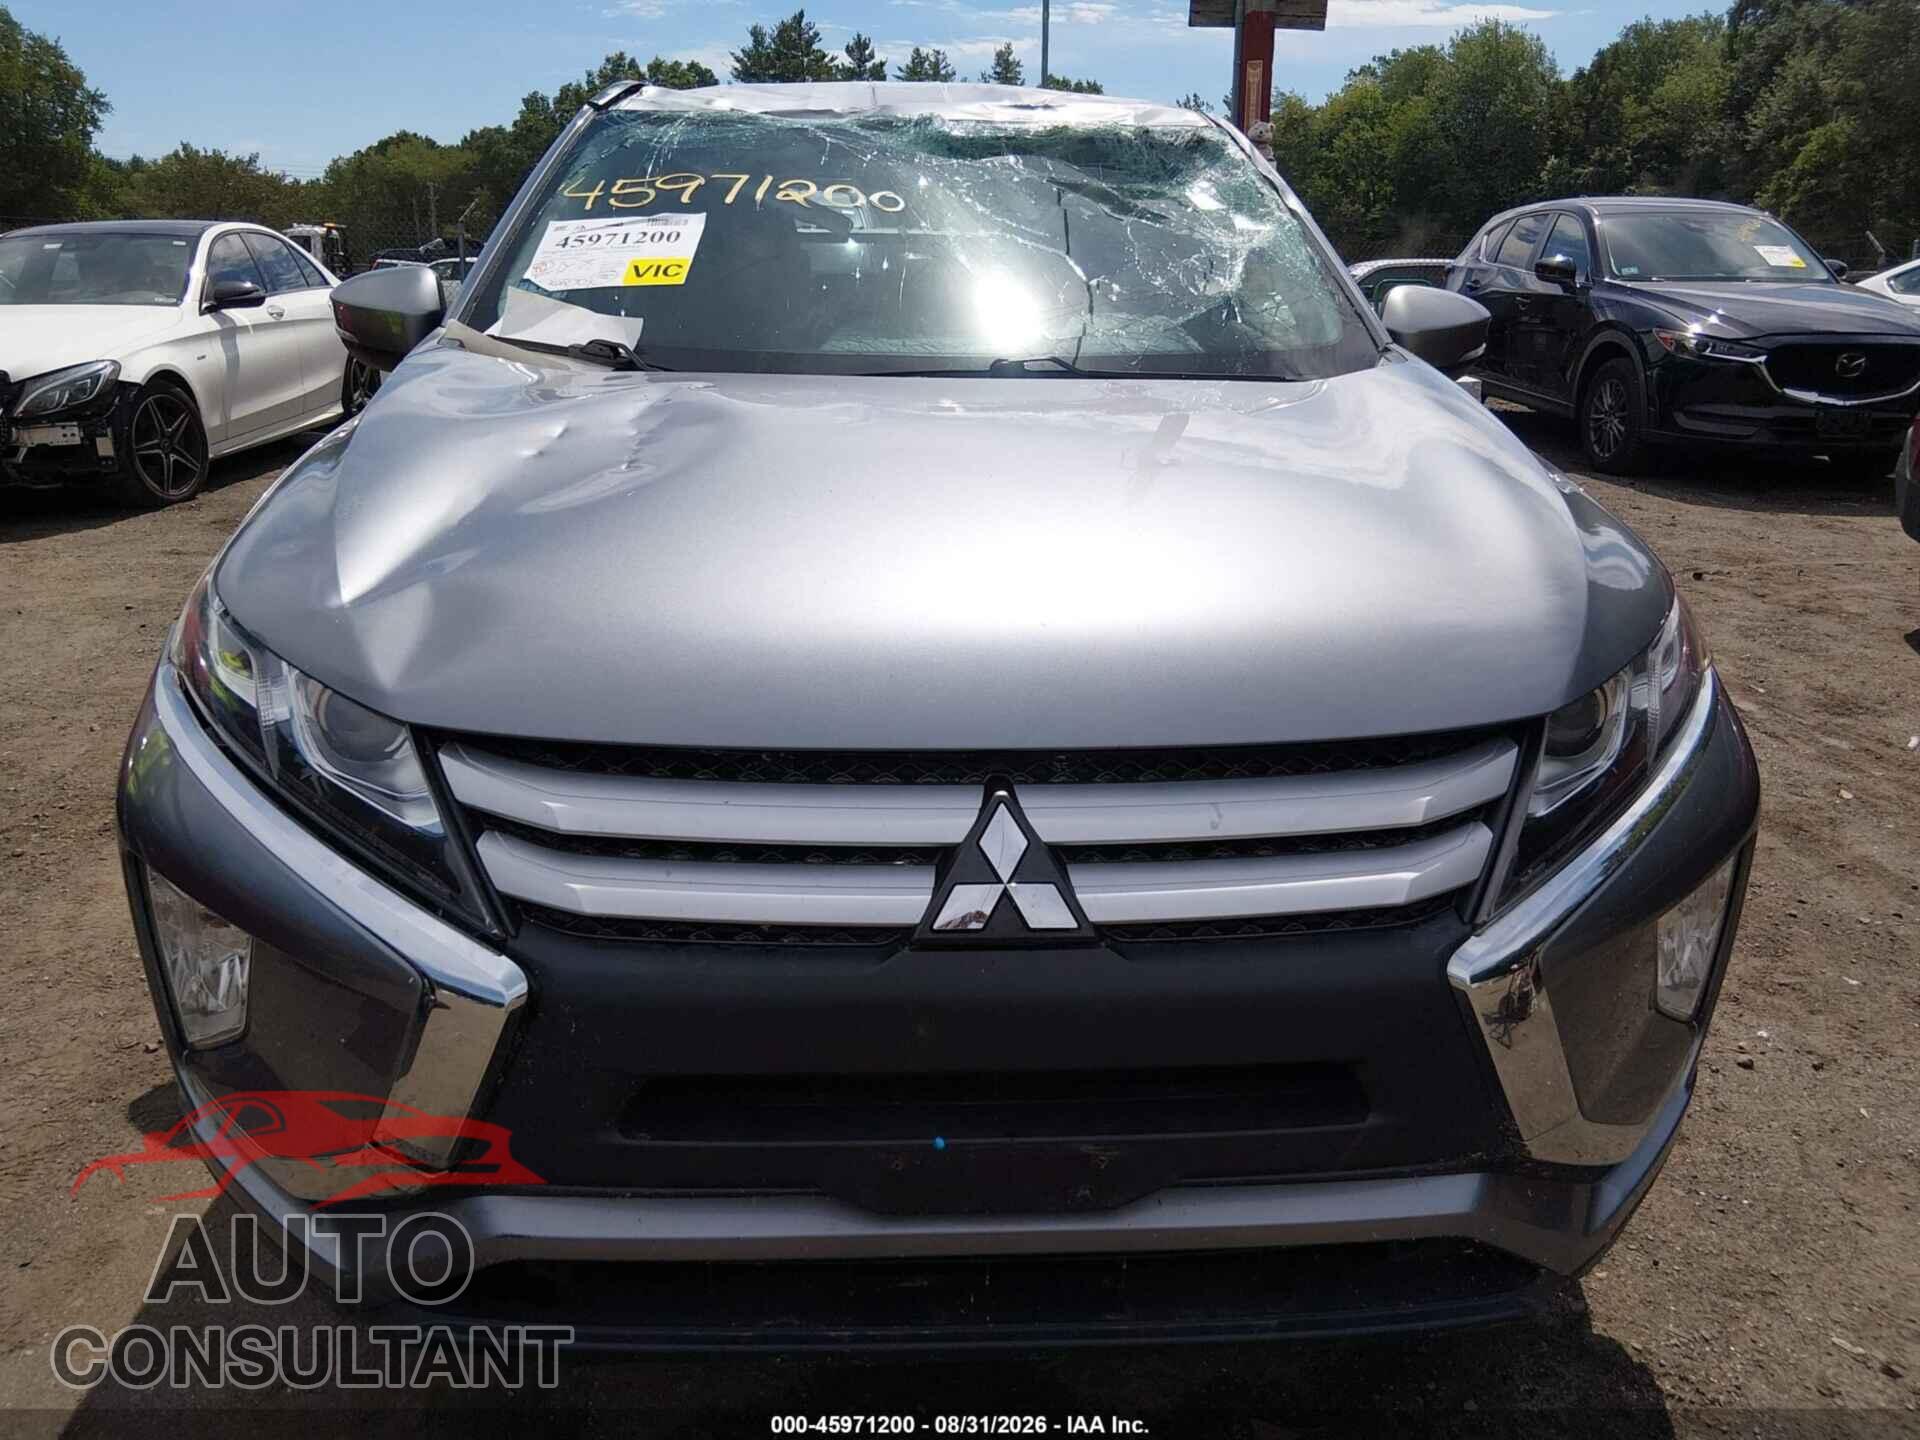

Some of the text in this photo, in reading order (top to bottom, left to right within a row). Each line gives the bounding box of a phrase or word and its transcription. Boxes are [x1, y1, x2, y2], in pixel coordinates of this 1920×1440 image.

[563, 172, 906, 212] 45971200
[555, 230, 681, 249] 45971200
[633, 263, 684, 278] VIC
